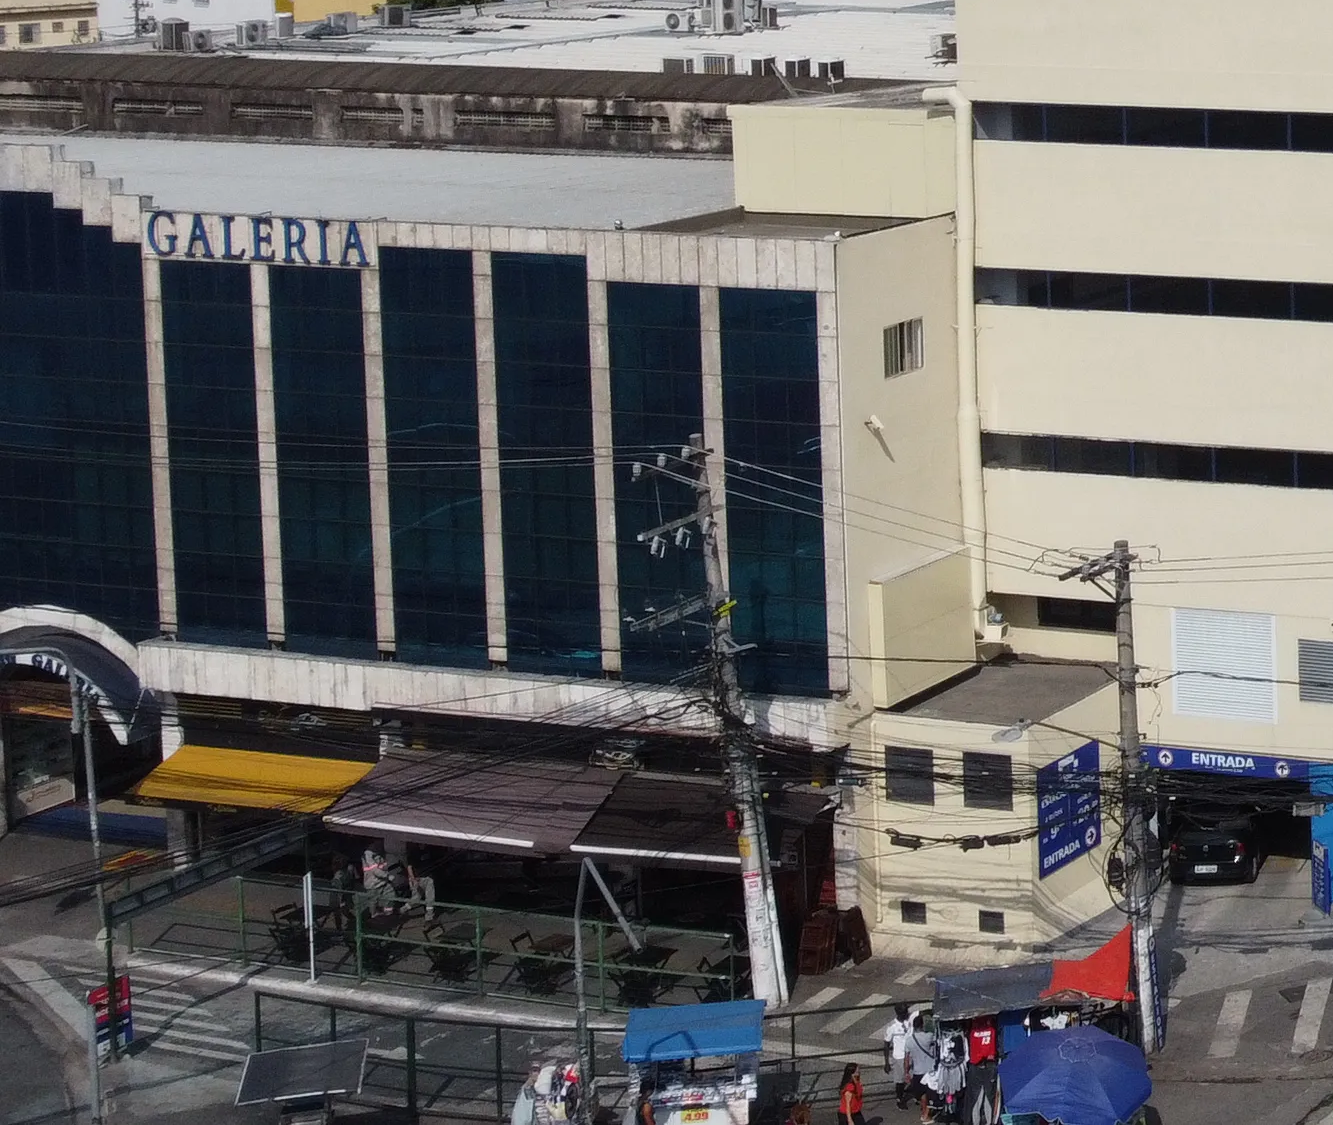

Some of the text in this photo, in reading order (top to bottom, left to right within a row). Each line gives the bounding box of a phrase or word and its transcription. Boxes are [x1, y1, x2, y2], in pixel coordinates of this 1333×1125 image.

[147, 210, 370, 267] GALERIA
[1191, 751, 1255, 770] ENTRADA
[1043, 839, 1081, 869] ENTRADA
